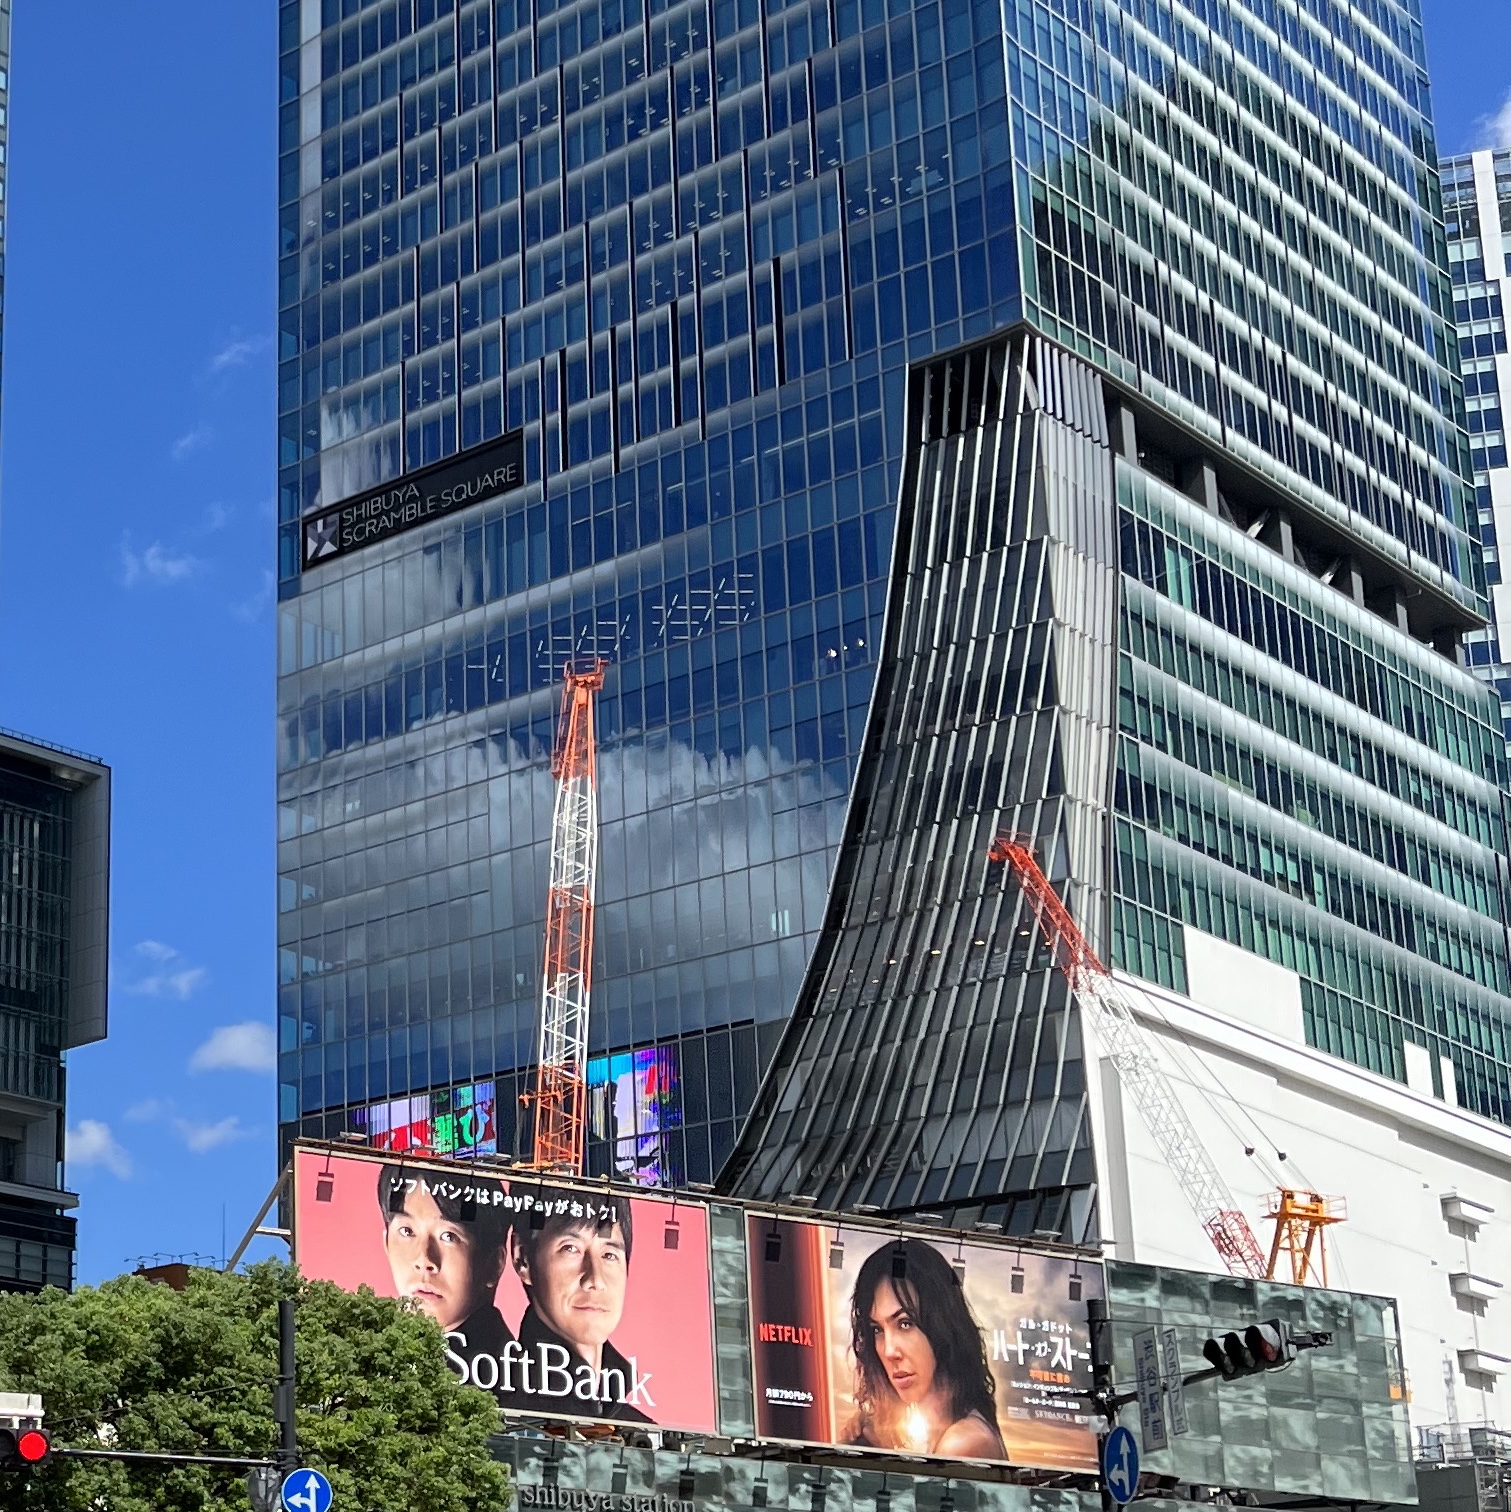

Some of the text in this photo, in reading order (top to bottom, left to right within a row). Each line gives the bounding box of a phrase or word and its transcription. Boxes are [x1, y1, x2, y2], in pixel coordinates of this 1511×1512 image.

[342, 483, 419, 526] SHIBUYA
[342, 463, 516, 547] SCRAMBLE SQUARE
[759, 1323, 813, 1347] NETFLIX
[444, 1331, 657, 1407] SoftBank
[520, 1482, 615, 1512] shibuya
